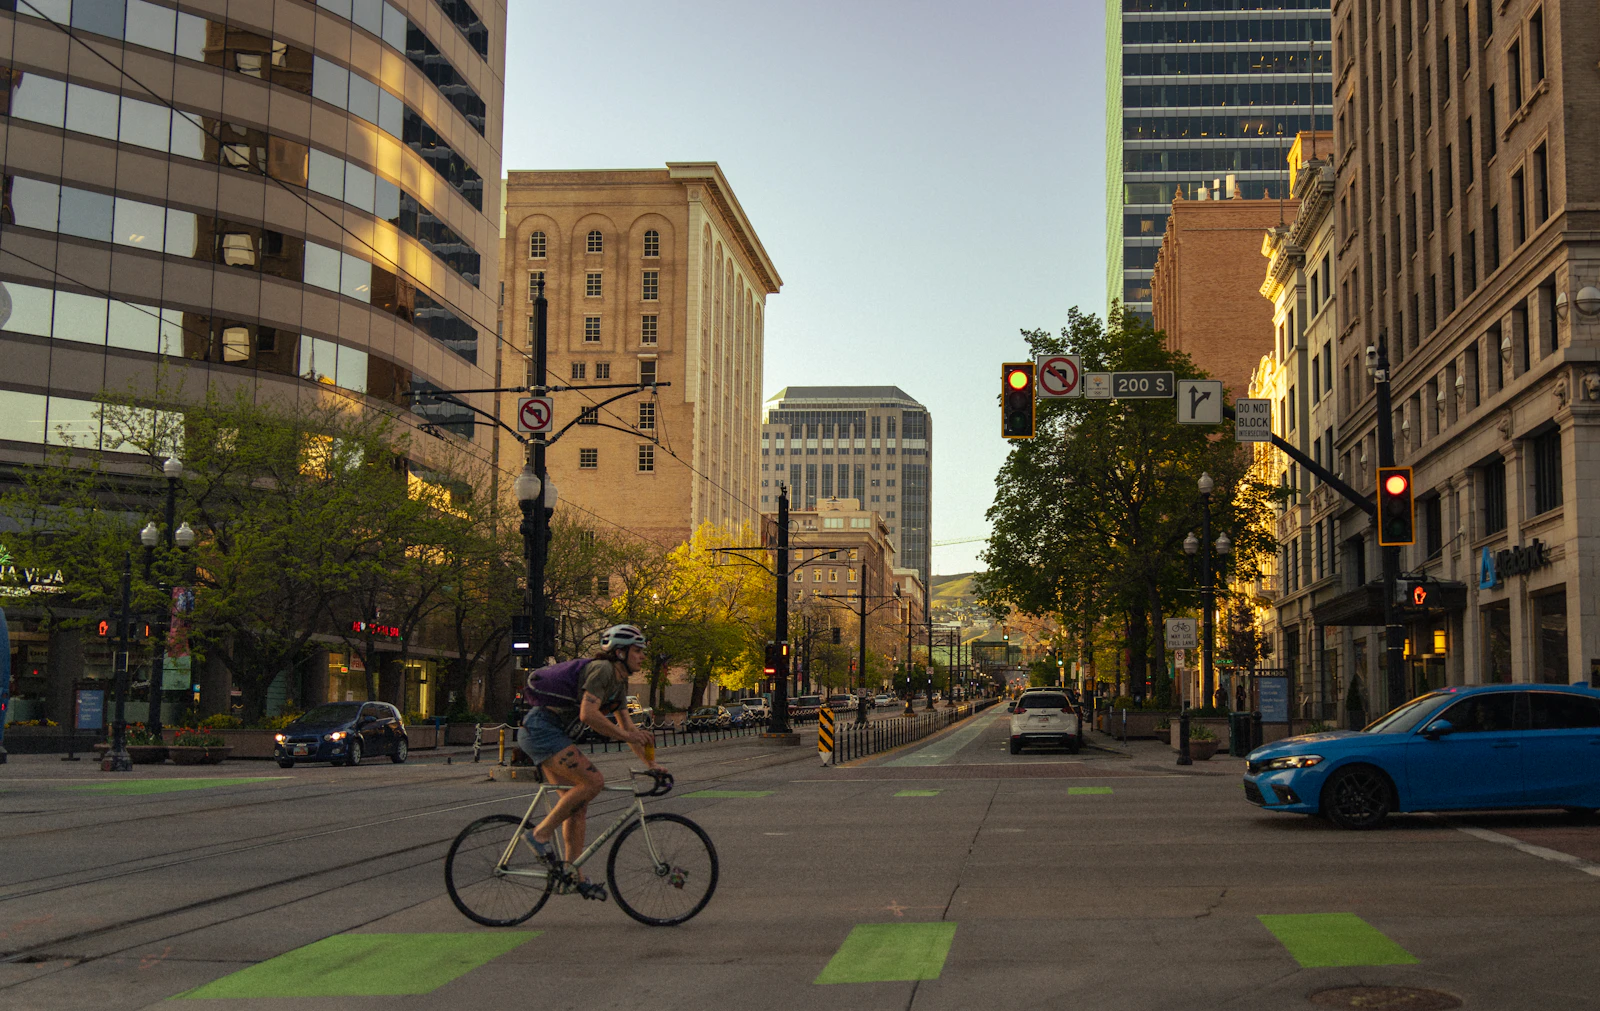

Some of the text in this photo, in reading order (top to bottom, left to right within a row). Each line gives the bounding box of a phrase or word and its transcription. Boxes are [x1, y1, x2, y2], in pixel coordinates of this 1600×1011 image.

[1118, 378, 1168, 392] 200 S.
[1239, 403, 1269, 413] DO NOT
[1239, 417, 1269, 428] BLOCK
